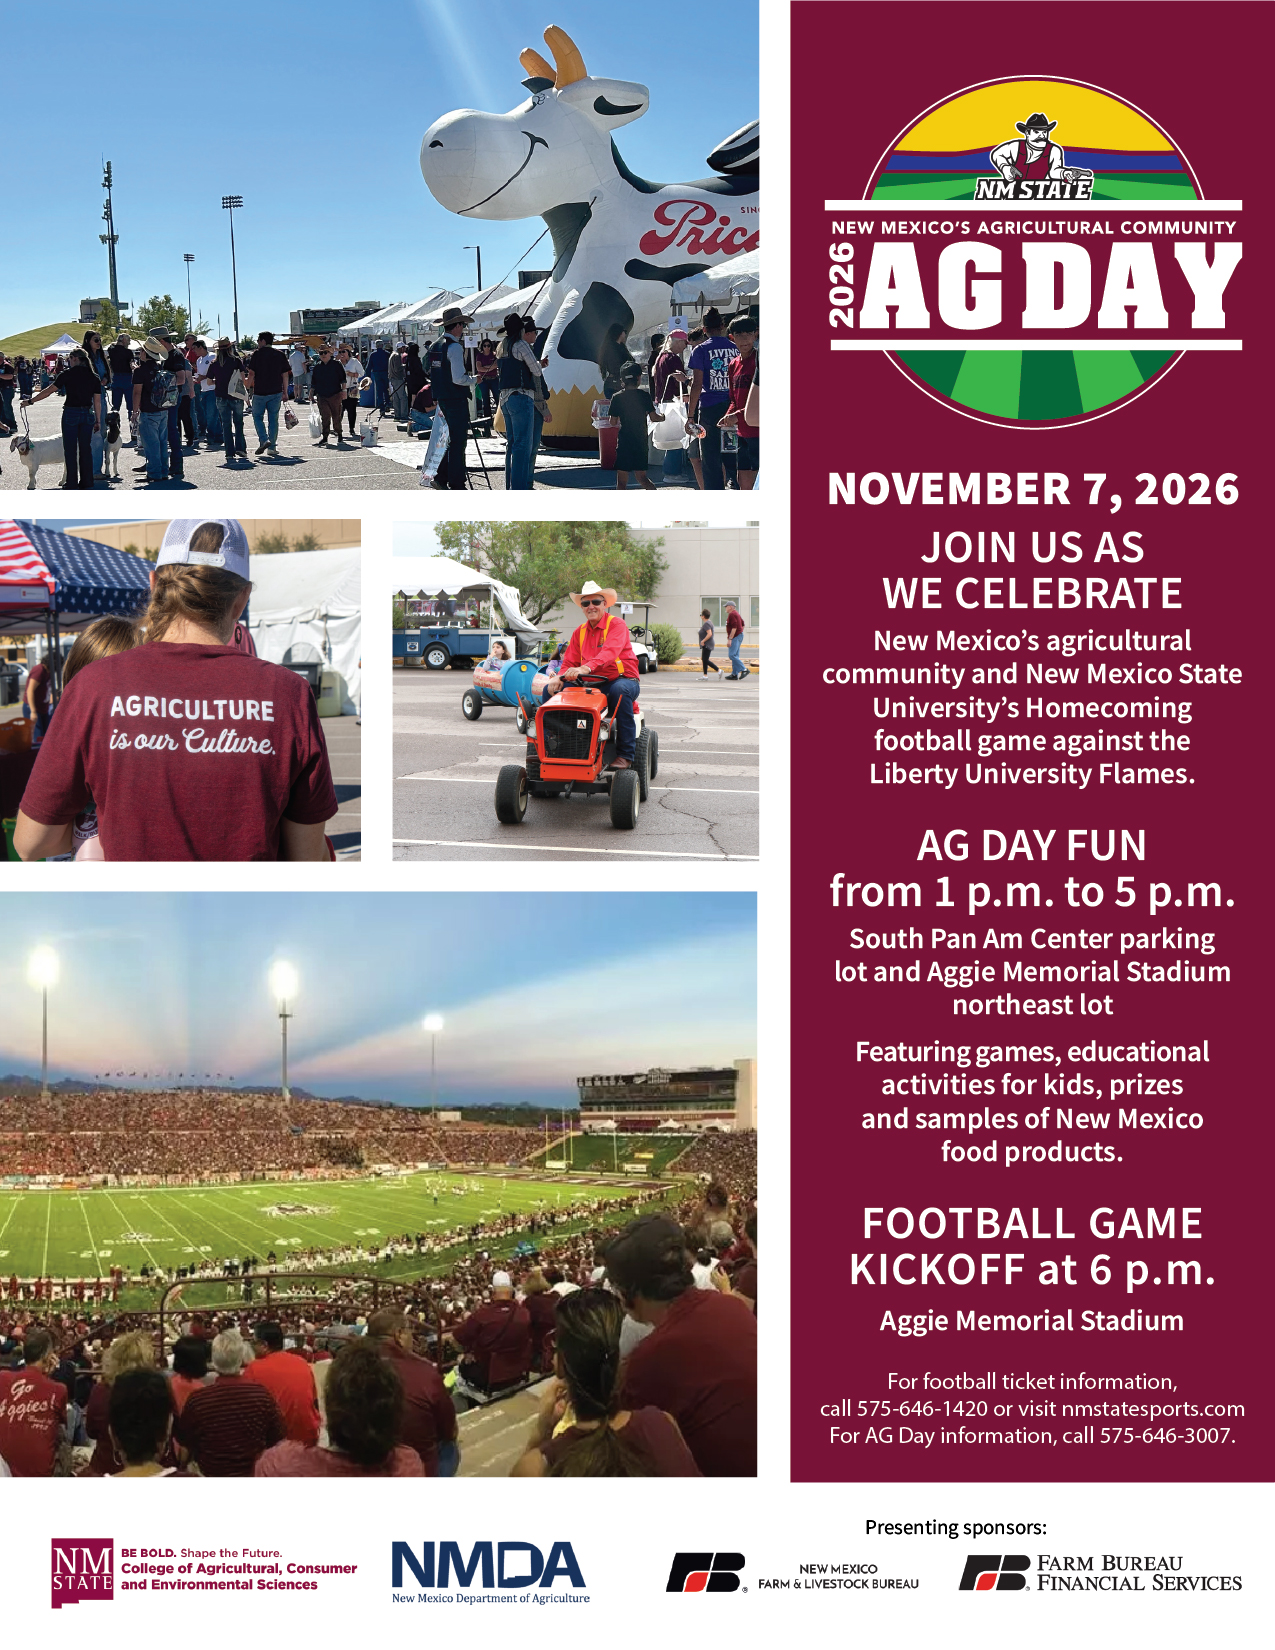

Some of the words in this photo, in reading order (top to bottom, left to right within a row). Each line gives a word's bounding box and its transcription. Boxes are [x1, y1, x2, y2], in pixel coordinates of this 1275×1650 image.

[977, 180, 1017, 199] NM
[1018, 180, 1091, 199] STATE
[741, 206, 759, 214] SIN
[833, 222, 874, 234] NEW
[882, 221, 970, 234] MEXICO’S
[977, 221, 1113, 234] AGRICULTURAL
[1121, 221, 1236, 234] COMMUNITY
[829, 242, 854, 328] 2026
[860, 241, 1001, 330] AG
[1022, 242, 1242, 328] DAY
[710, 370, 729, 378] SAL
[710, 377, 729, 390] PARA
[830, 472, 1070, 505] NOVEMBER
[1084, 474, 1121, 514] 7,
[1136, 473, 1238, 505] 2026
[921, 532, 1014, 562] JOIN
[1033, 532, 1082, 562] US
[1094, 532, 1143, 562] AS
[883, 578, 941, 608] WE
[956, 578, 1181, 608] CELEBRATE
[875, 631, 928, 650] New
[937, 629, 1039, 650] Mexico’s
[1047, 629, 1191, 656] agricultural
[823, 662, 965, 689] community
[972, 662, 1016, 683] and
[1027, 664, 1079, 683] New
[1088, 662, 1172, 683] Mexico
[1179, 664, 1242, 683] State
[111, 695, 274, 721] AGRICULTURE
[874, 696, 1019, 723] University’s
[1027, 696, 1192, 723] Homecoming
[110, 729, 131, 749] is
[134, 734, 179, 750] our
[182, 728, 275, 754] Culture.
[875, 729, 971, 750] football
[978, 735, 1046, 756] game
[1053, 729, 1143, 756] against
[1150, 729, 1190, 750] the
[871, 762, 958, 789] Liberty
[966, 762, 1092, 789] University
[1100, 762, 1194, 783] Flames.
[917, 830, 968, 860] AG
[984, 830, 1056, 860] DAY
[1069, 830, 1144, 860] FUN
[830, 873, 920, 906] from
[936, 877, 954, 906] 1
[969, 883, 1053, 915] p.m.
[1065, 877, 1103, 906] to
[1115, 877, 1135, 906] 5
[1150, 883, 1234, 915] p.m.
[850, 927, 922, 948] South
[932, 929, 975, 948] Pan
[983, 929, 1022, 948] Am
[1031, 929, 1113, 948] Center
[1121, 927, 1215, 954] parking
[836, 960, 867, 981] lot
[874, 960, 919, 981] and
[927, 960, 995, 987] Aggie
[1004, 960, 1119, 981] Memorial
[1127, 960, 1230, 981] Stadium
[954, 993, 1073, 1014] northeast
[1081, 993, 1113, 1014] lot
[857, 1040, 971, 1067] Featuring
[976, 1046, 1061, 1067] games,
[1068, 1040, 1209, 1061] educational
[882, 1073, 995, 1094] activities
[1002, 1073, 1037, 1094] for
[1045, 1073, 1102, 1099] kids,
[1111, 1073, 1183, 1100] prizes
[862, 1107, 907, 1128] and
[916, 1107, 1018, 1134] samples
[1025, 1107, 1050, 1128] of
[1057, 1109, 1110, 1128] New
[1119, 1107, 1203, 1128] Mexico
[942, 1140, 996, 1161] food
[1006, 1140, 1122, 1167] products.
[865, 1208, 1075, 1238] FOOTBALL
[1090, 1208, 1201, 1238] GAME
[852, 1254, 1024, 1284] KICKOFF
[1039, 1255, 1077, 1284] at
[1091, 1254, 1111, 1284] 6
[1127, 1261, 1214, 1293] p.m.
[880, 1309, 948, 1336] Aggie
[957, 1309, 1073, 1330] Memorial
[1081, 1309, 1183, 1330] Stadium
[11, 1379, 34, 1401] Go
[889, 1373, 918, 1389] For
[923, 1372, 995, 1389] football
[1002, 1372, 1055, 1389] ticket
[1061, 1372, 1176, 1392] information,
[821, 1399, 850, 1416] call
[858, 1401, 987, 1416] 575-646-1420
[994, 1405, 1013, 1416] or
[1019, 1400, 1056, 1416] visit
[1063, 1402, 1244, 1421] nmstatesports.com
[831, 1427, 860, 1443] For
[865, 1427, 892, 1443] AG
[900, 1427, 935, 1448] Day
[941, 1426, 1057, 1446] information,
[1063, 1426, 1093, 1443] call
[1101, 1428, 1235, 1443] 575-646-3007.
[867, 1519, 959, 1539] Presenting
[964, 1523, 1046, 1539] sponsors:
[54, 1548, 112, 1574] NM
[122, 1549, 136, 1557] BE
[141, 1549, 176, 1557] BOLD.
[181, 1549, 216, 1559] Shape
[220, 1548, 238, 1557] the
[243, 1549, 282, 1557] Future.
[392, 1541, 586, 1588] NMDA
[1037, 1555, 1093, 1571] FARM
[1102, 1555, 1183, 1571] BUREAU
[122, 1563, 174, 1575] College
[178, 1563, 192, 1573] of
[196, 1563, 282, 1575] Agricultural,
[287, 1563, 357, 1573] Consumer
[800, 1564, 828, 1574] NEW
[831, 1564, 878, 1574] MEXICO
[54, 1576, 112, 1589] STATE
[121, 1579, 146, 1590] and
[152, 1579, 252, 1590] Environmental
[257, 1579, 317, 1590] Sciences
[759, 1579, 789, 1588] FARM
[794, 1579, 801, 1589] &
[805, 1579, 869, 1589] LIVESTOCK
[873, 1579, 918, 1589] BUREAU
[1037, 1574, 1145, 1591] FINANCIAL
[1153, 1574, 1242, 1591] SERVICES
[392, 1593, 415, 1603] New
[418, 1593, 453, 1603] Mexico
[456, 1593, 517, 1605] Department
[519, 1593, 530, 1603] of
[532, 1593, 590, 1605] Agriculture
